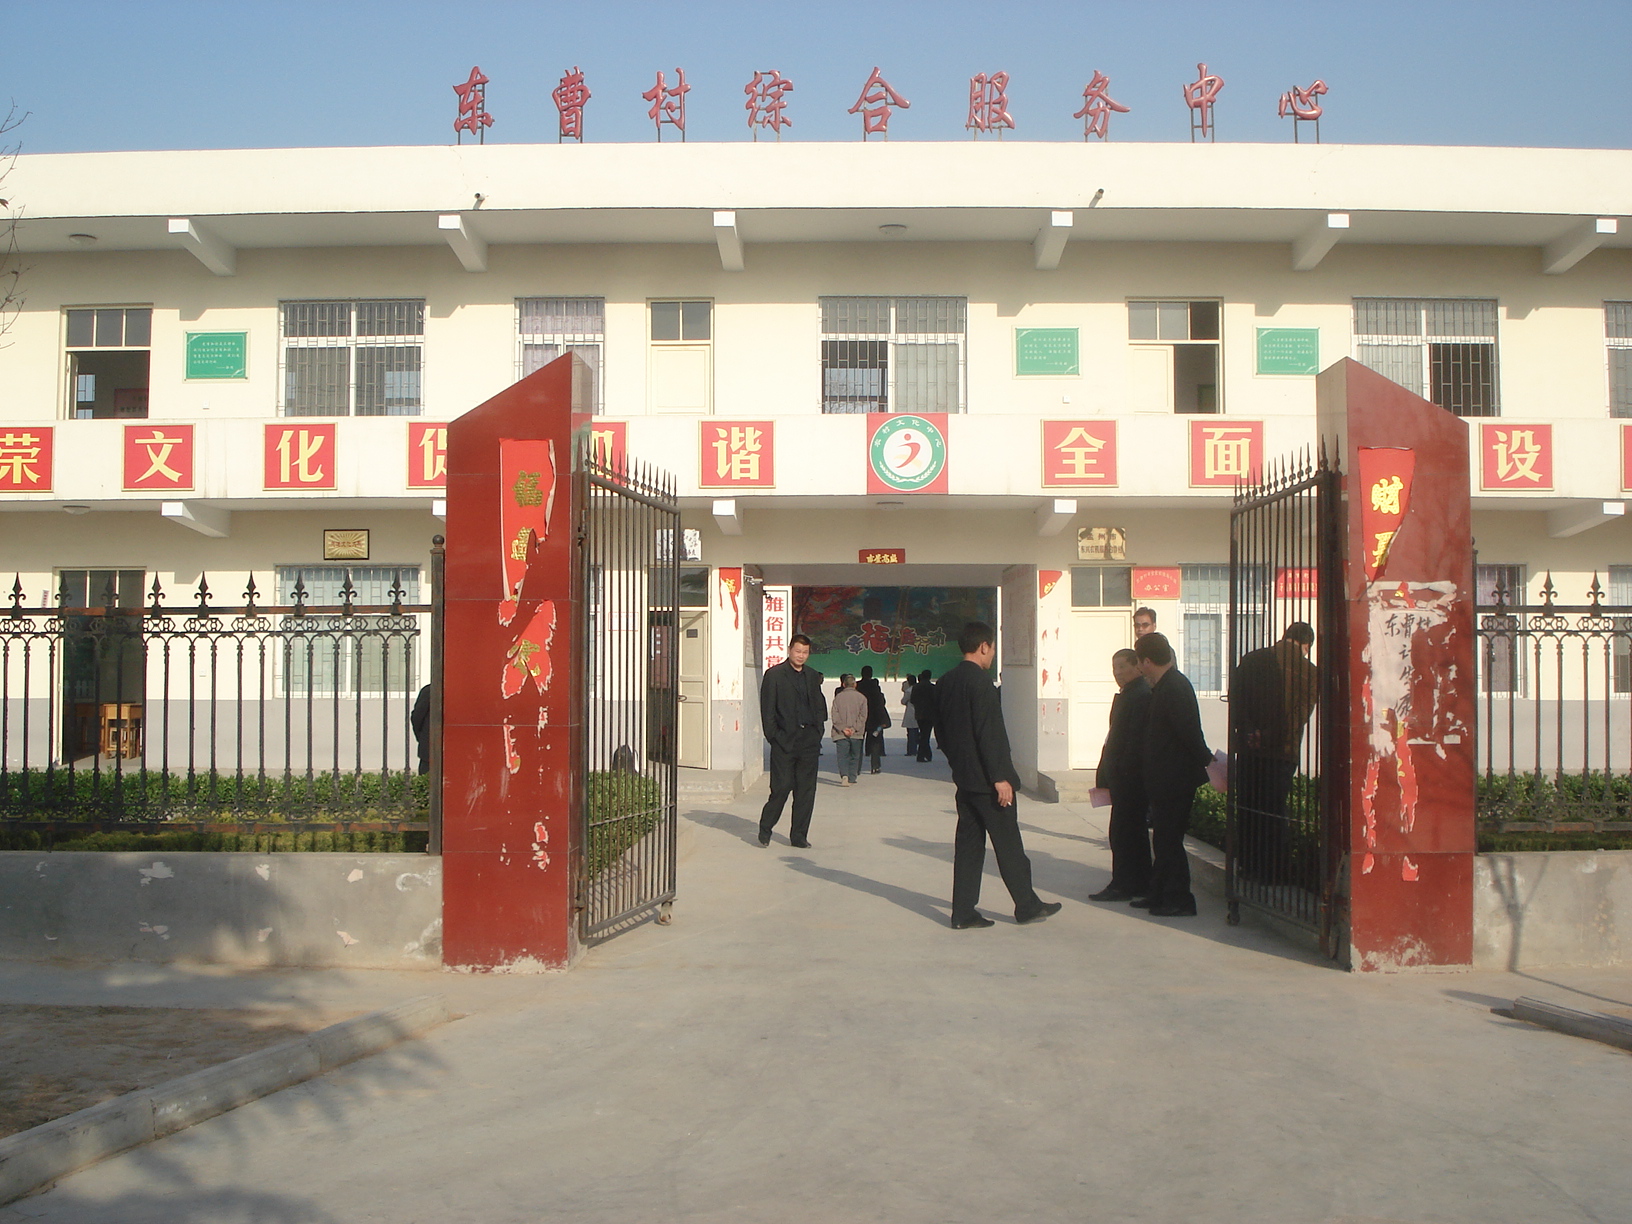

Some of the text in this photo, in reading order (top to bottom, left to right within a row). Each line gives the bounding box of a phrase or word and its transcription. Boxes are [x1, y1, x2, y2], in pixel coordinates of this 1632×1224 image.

[453, 63, 1329, 139] 东曹村综合服务中心
